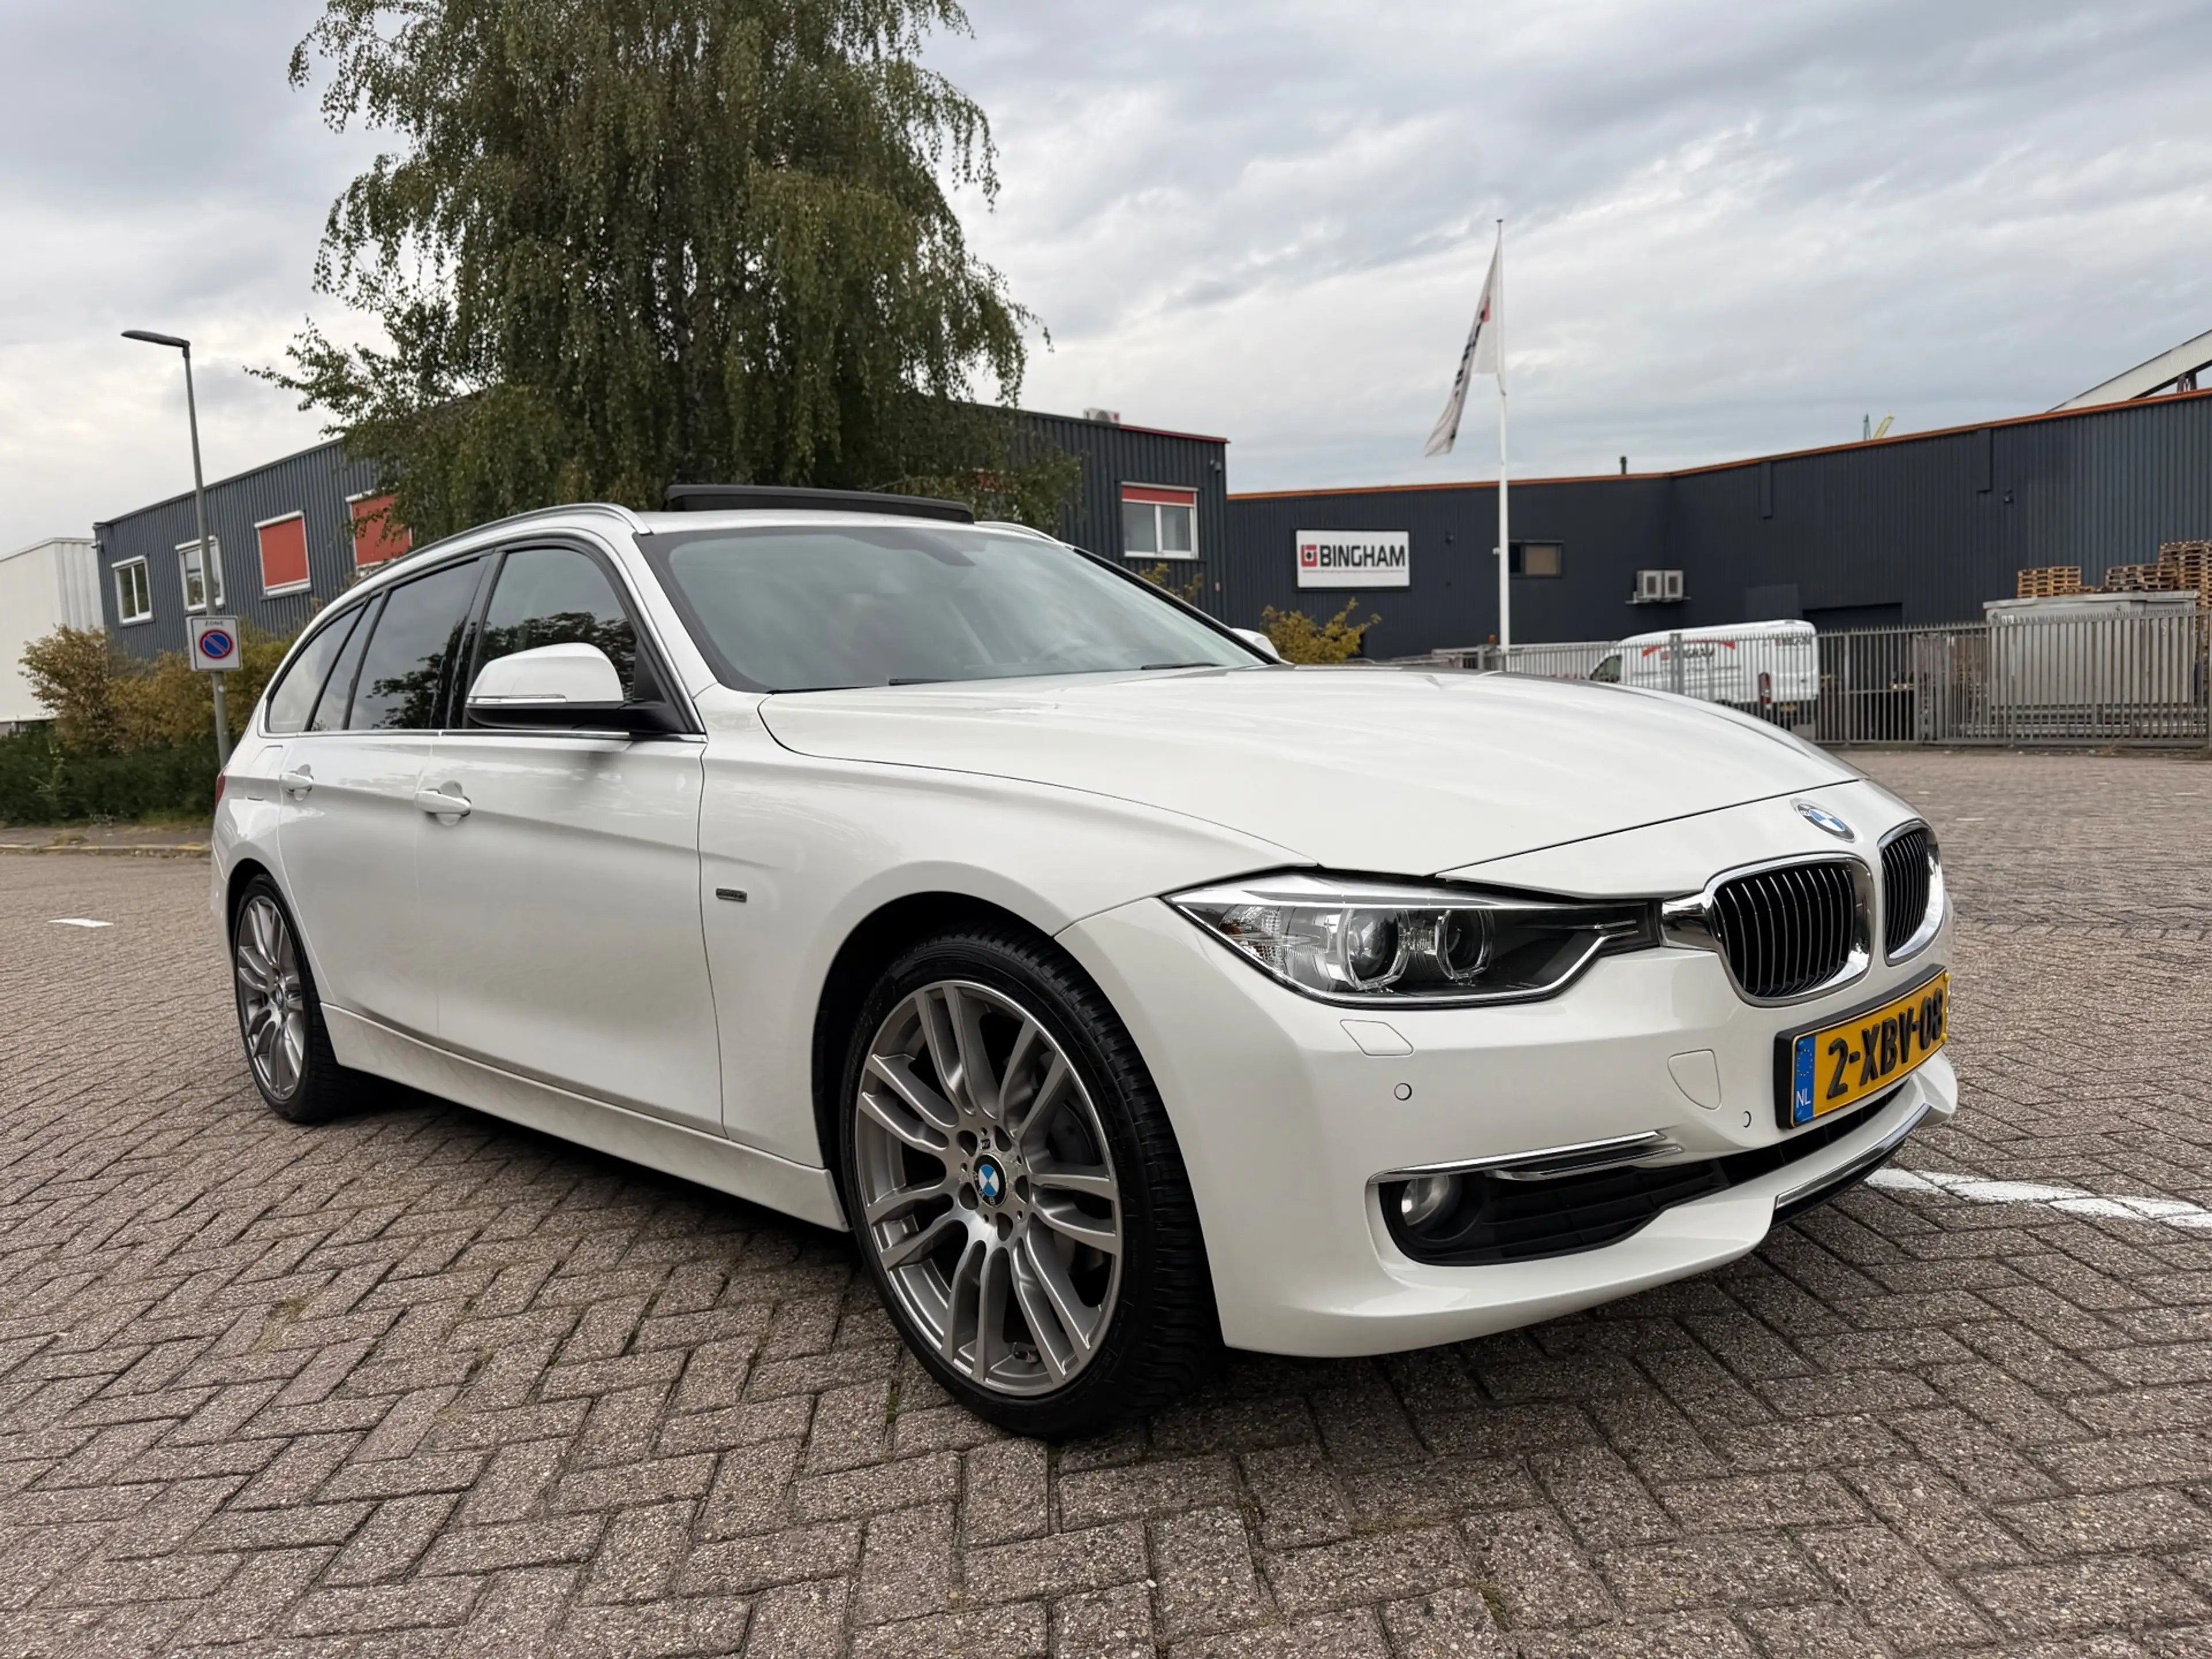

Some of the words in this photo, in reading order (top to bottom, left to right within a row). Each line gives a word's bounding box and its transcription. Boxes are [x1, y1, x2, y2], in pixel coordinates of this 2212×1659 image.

[1320, 545, 1406, 567] BINGHAM
[1826, 987, 1943, 1100] 2-XBV-08
[1796, 1088, 1811, 1107] NL
